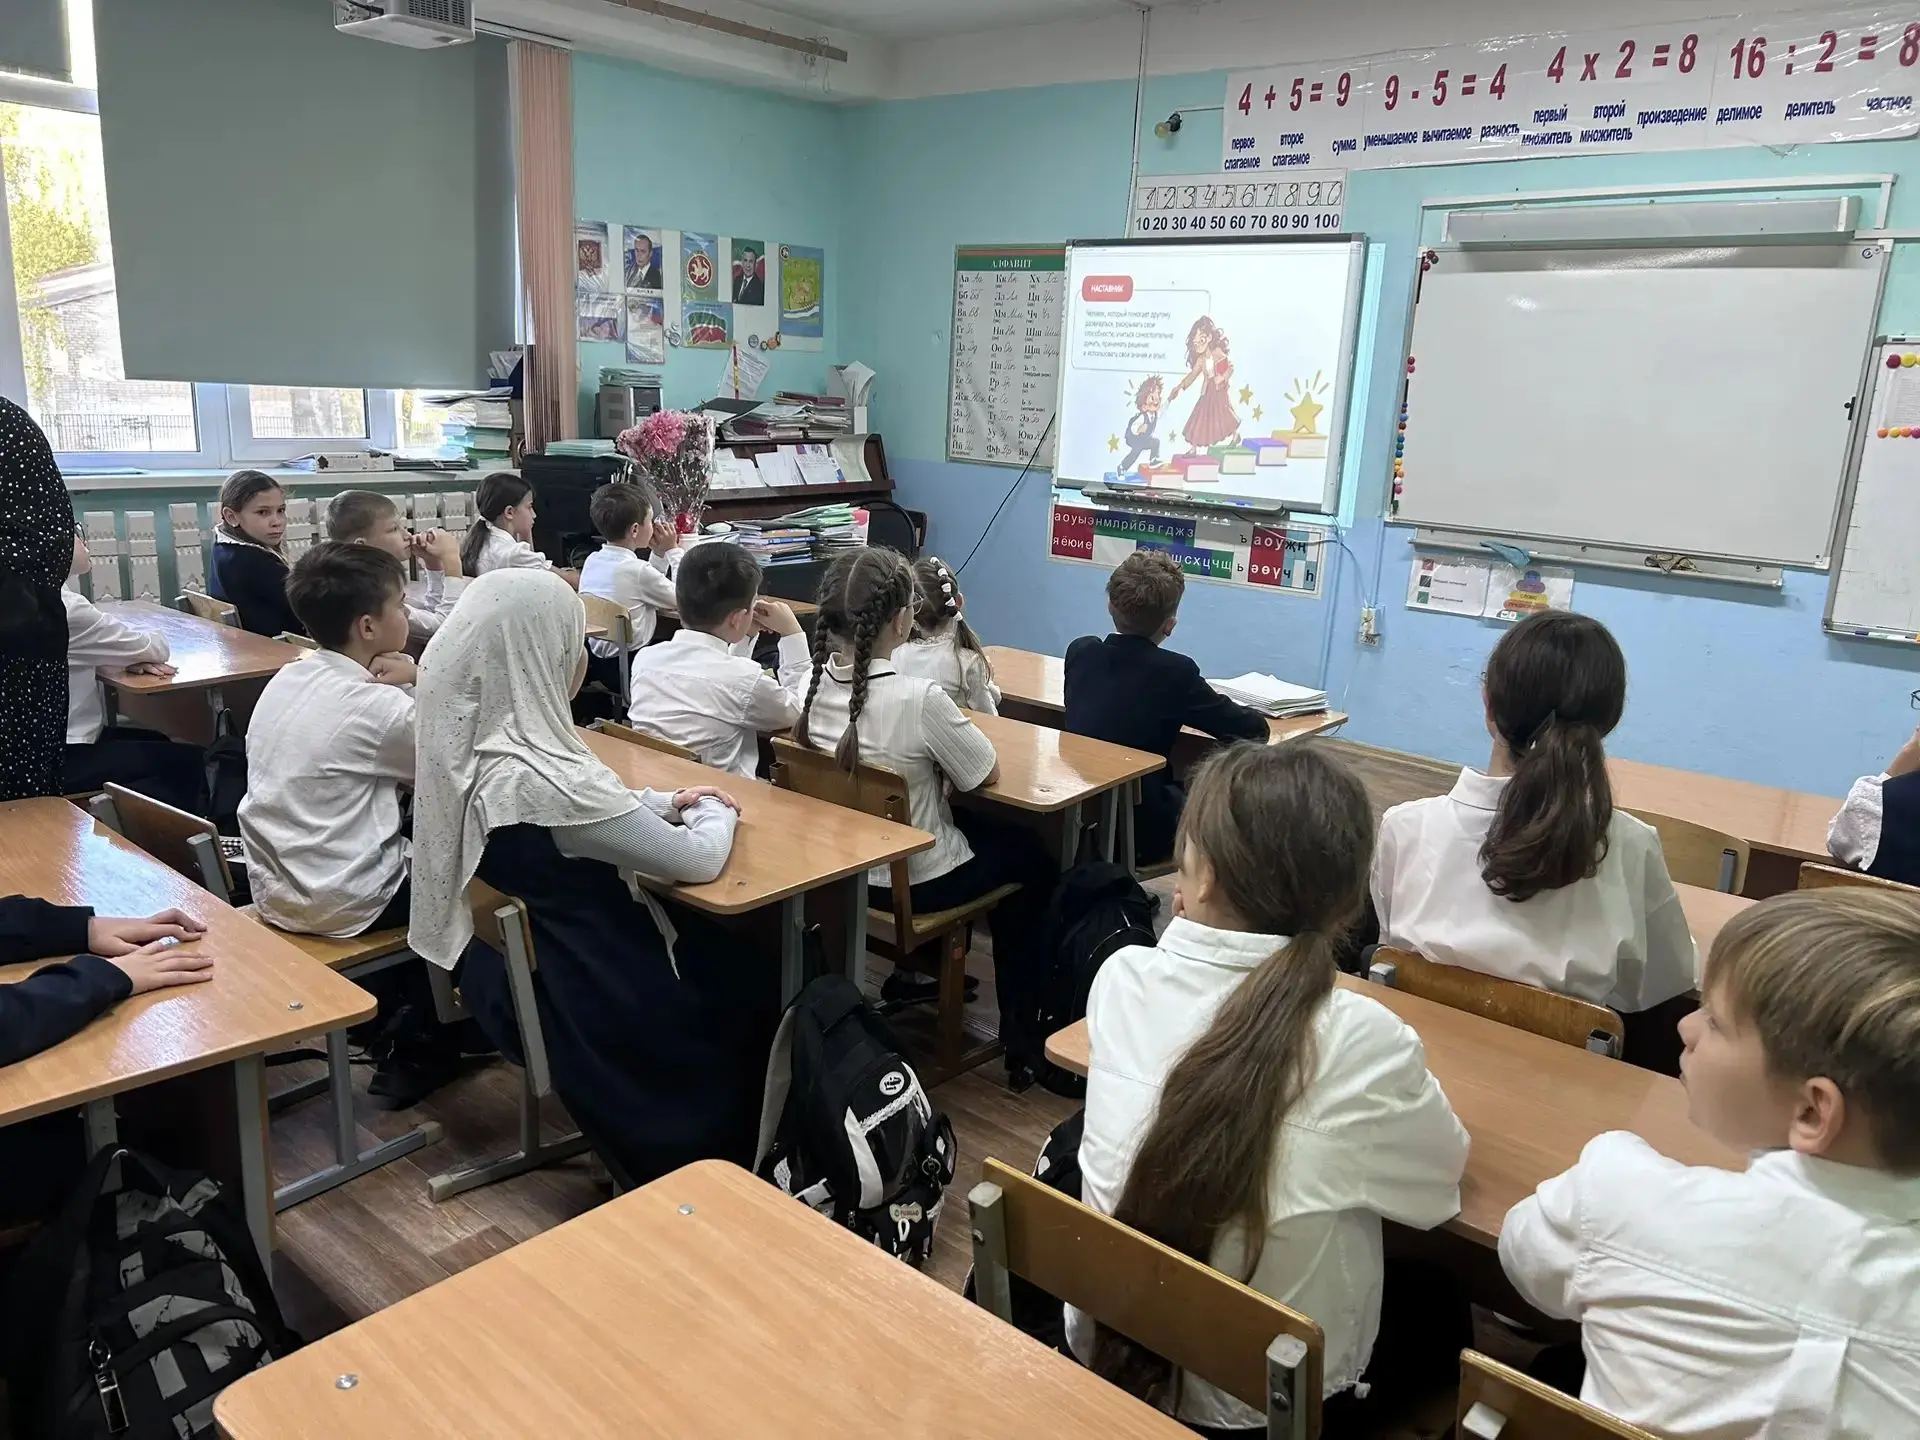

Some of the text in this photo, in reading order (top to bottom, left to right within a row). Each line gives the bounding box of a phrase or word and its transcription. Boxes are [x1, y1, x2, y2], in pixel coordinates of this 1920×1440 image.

[1547, 46, 1566, 83] 4
[1615, 40, 1636, 78] 2
[1652, 44, 1670, 66] =
[1678, 34, 1698, 74] 8
[1730, 22, 1920, 79] 16 : 2 = 8
[1238, 72, 1351, 116] 4 + 5 = 9
[1384, 74, 1399, 110] 9
[1432, 70, 1450, 106] 5
[1461, 74, 1477, 96] =
[1489, 63, 1508, 100] 4
[1533, 99, 1626, 126] первый второй
[1637, 106, 1708, 128] произведение
[1716, 94, 1913, 125] делимое делитель частное
[1232, 132, 1304, 152] первое второе
[1332, 138, 1357, 156] сумма
[1363, 122, 1520, 151] уменьшаемое вычитаемое разность
[1521, 126, 1633, 146] множитель множитель
[1224, 152, 1310, 170] слагаемое слагаемое
[1136, 214, 1340, 230] 10 20 30 40 50 60 70 80 90 100
[1090, 284, 1124, 293] НАСТАВНИК
